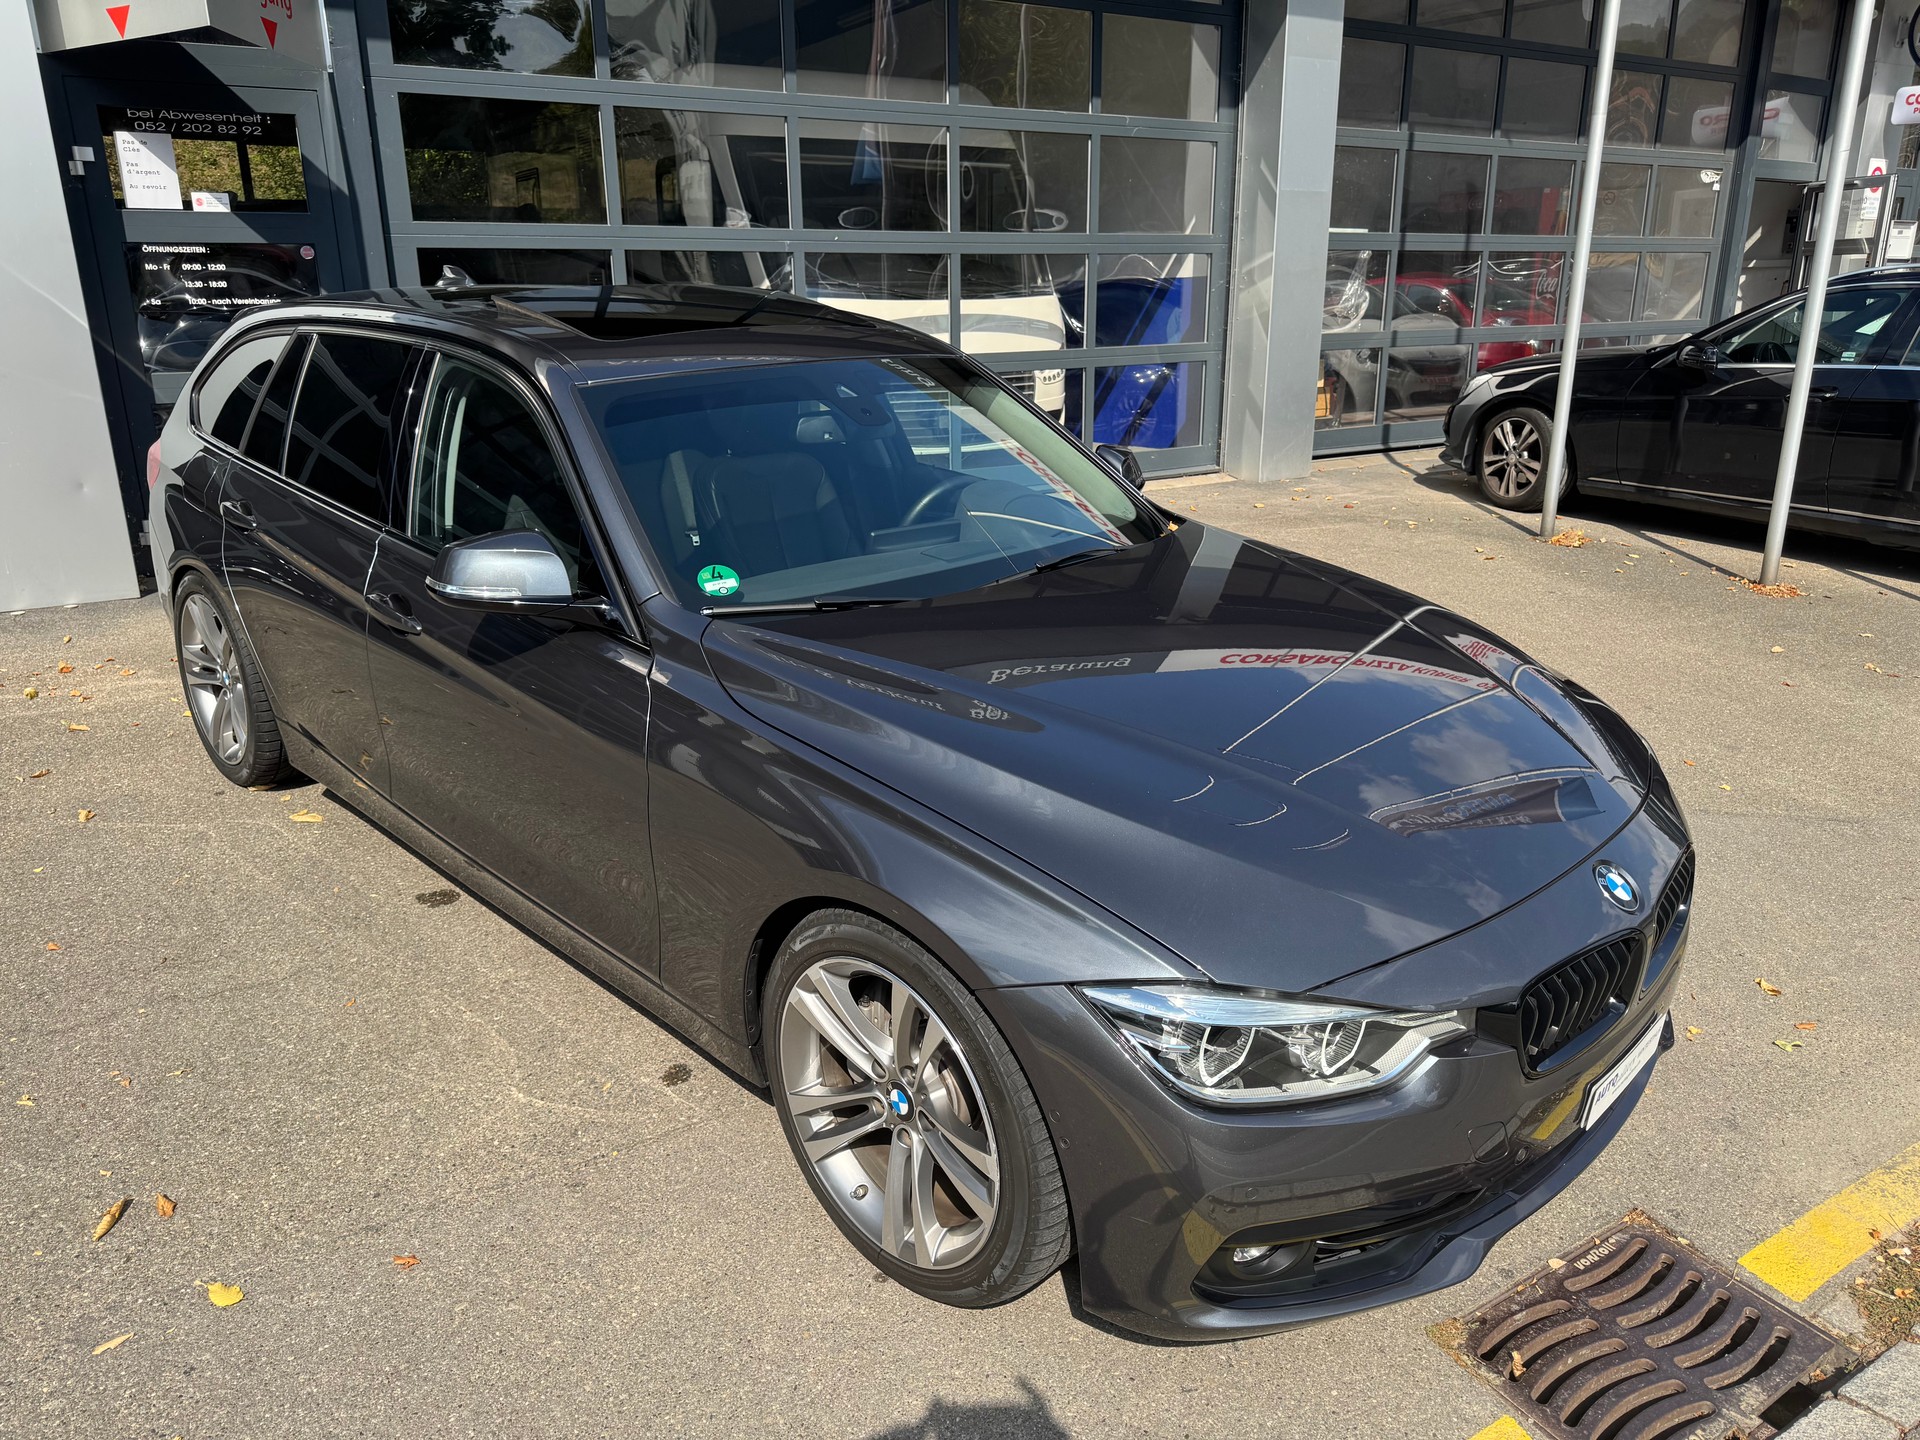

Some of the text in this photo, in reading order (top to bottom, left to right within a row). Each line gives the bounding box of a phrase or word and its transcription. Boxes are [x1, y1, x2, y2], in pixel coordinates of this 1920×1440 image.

[126, 108, 154, 119] bei
[158, 109, 262, 123] Abwesenheit
[134, 121, 166, 131] 052
[181, 123, 213, 133] 202
[217, 125, 238, 134] 82
[242, 126, 263, 136] 92
[126, 168, 161, 176] d'argent
[142, 244, 206, 254] ÖFFNUNGSZEITEN
[144, 263, 158, 271] Mo
[163, 263, 171, 271] Fr
[181, 263, 202, 271] 09:00
[207, 263, 226, 271] 12:00
[184, 280, 203, 288] 13:30
[209, 280, 227, 288] 18:00
[188, 297, 207, 306] 10:00
[212, 297, 231, 306] nach
[711, 565, 724, 580] 4
